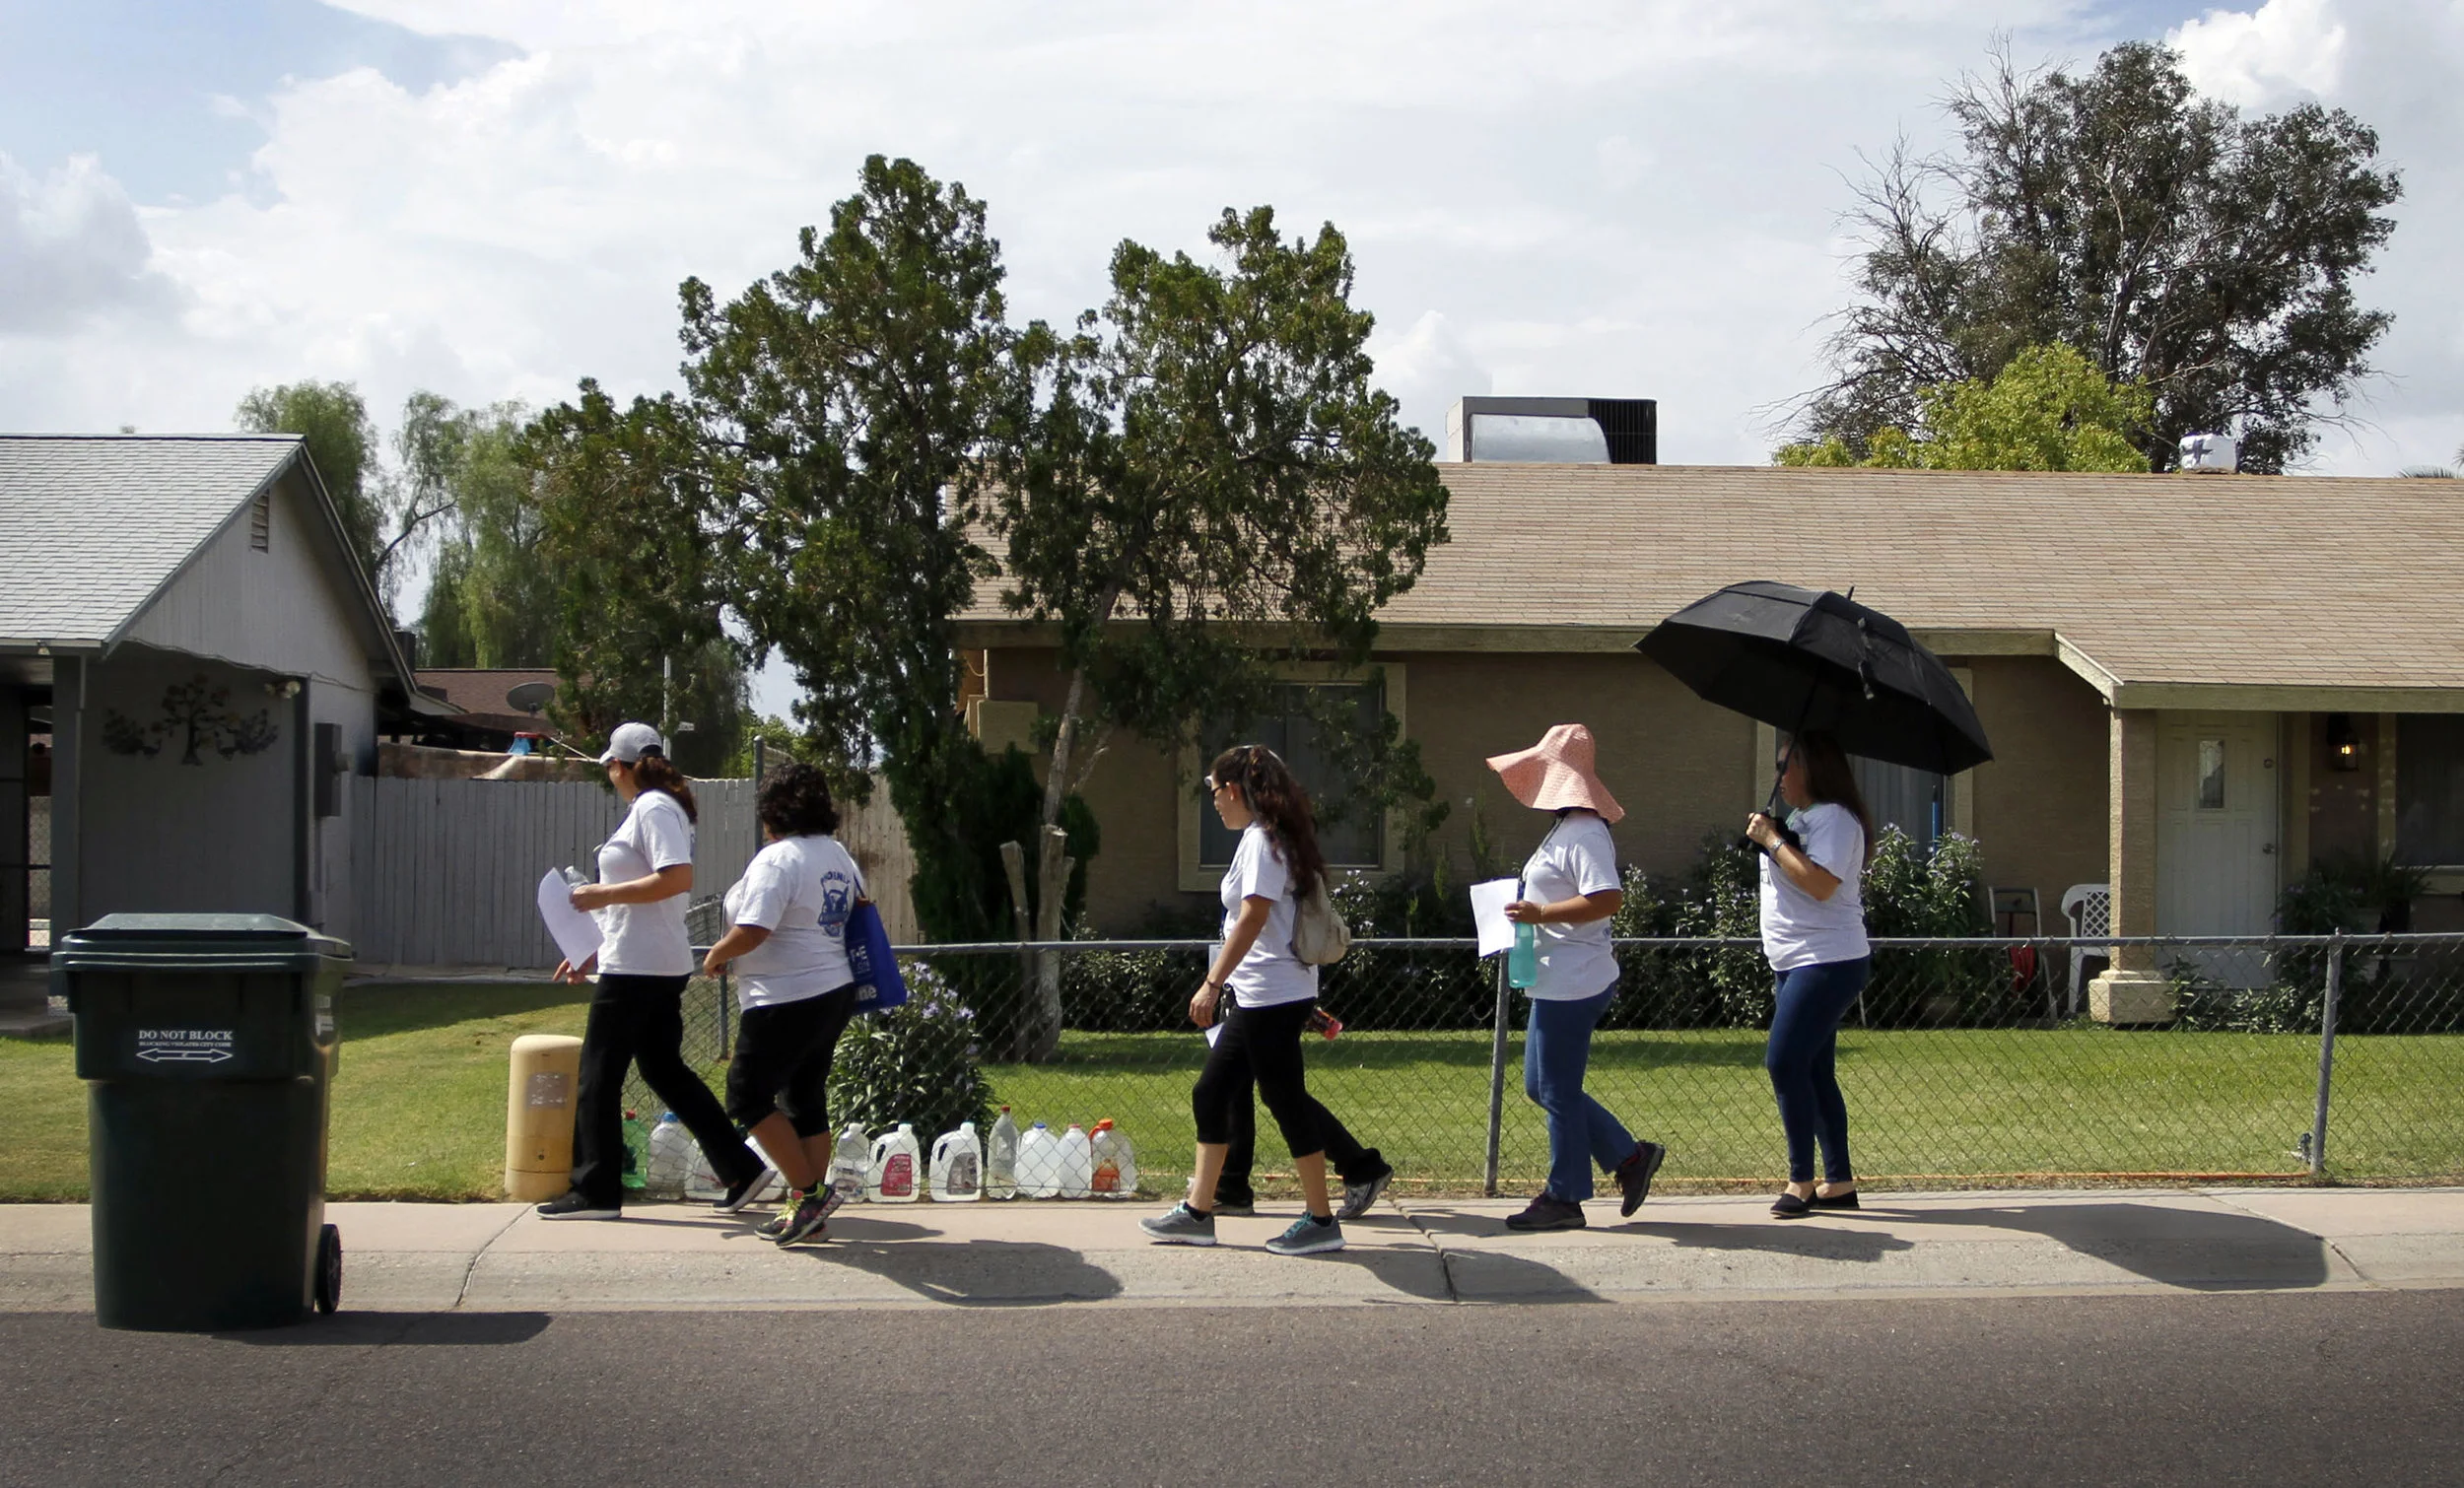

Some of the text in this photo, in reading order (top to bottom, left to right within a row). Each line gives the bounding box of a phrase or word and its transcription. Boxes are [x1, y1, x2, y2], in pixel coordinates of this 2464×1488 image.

[139, 1030, 232, 1041] DO NOT BLOCK
